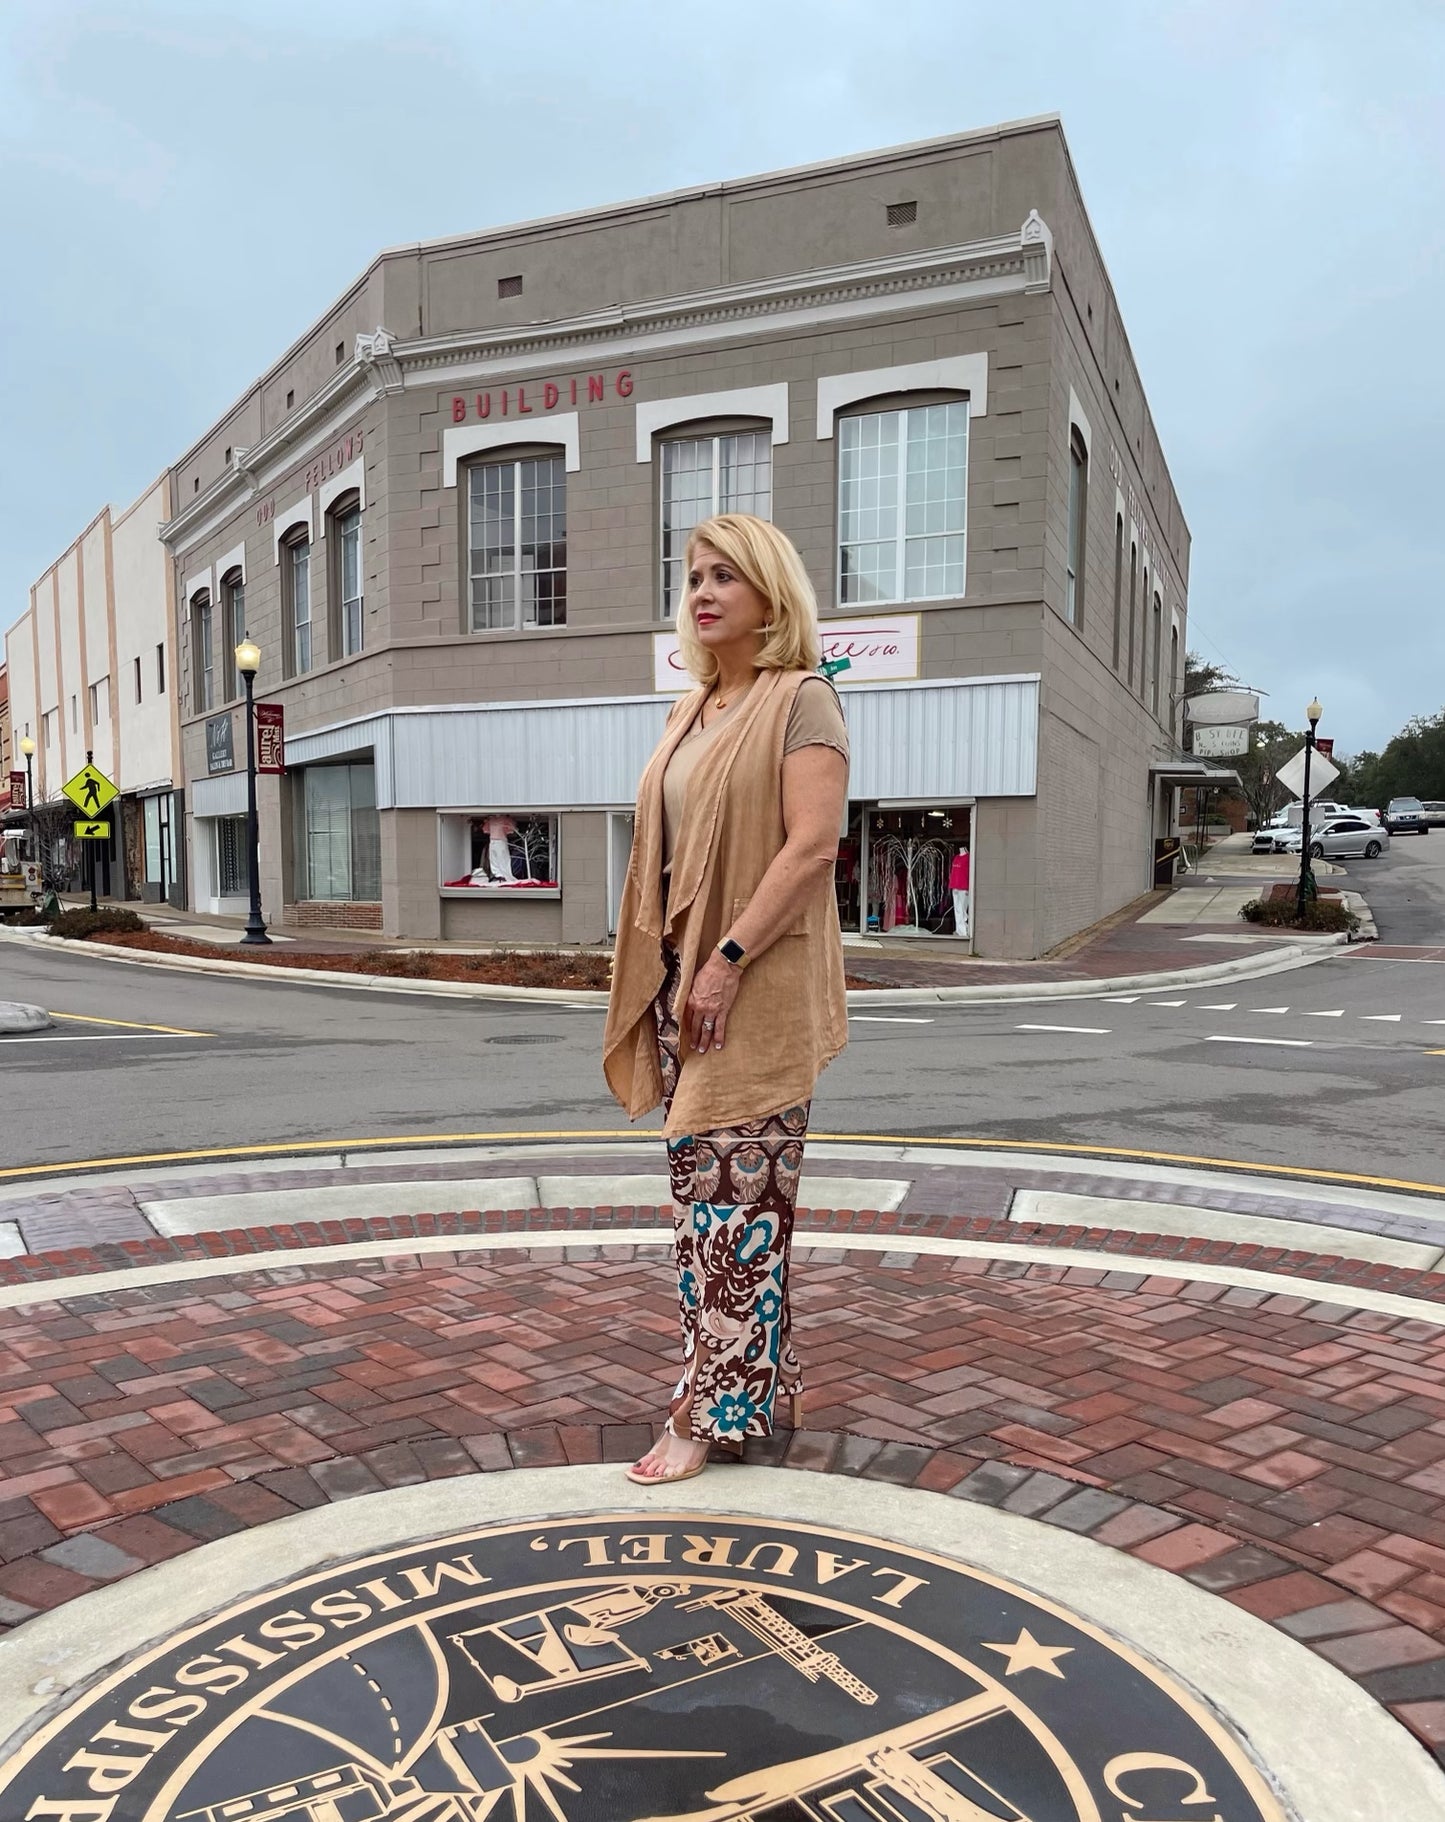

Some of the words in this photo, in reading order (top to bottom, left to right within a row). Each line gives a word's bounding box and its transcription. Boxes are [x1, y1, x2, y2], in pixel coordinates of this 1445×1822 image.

[452, 371, 633, 423] BUILDING
[256, 496, 276, 527] ODD
[305, 430, 365, 493] FELLOWS
[529, 1532, 931, 1609] LAUREL,
